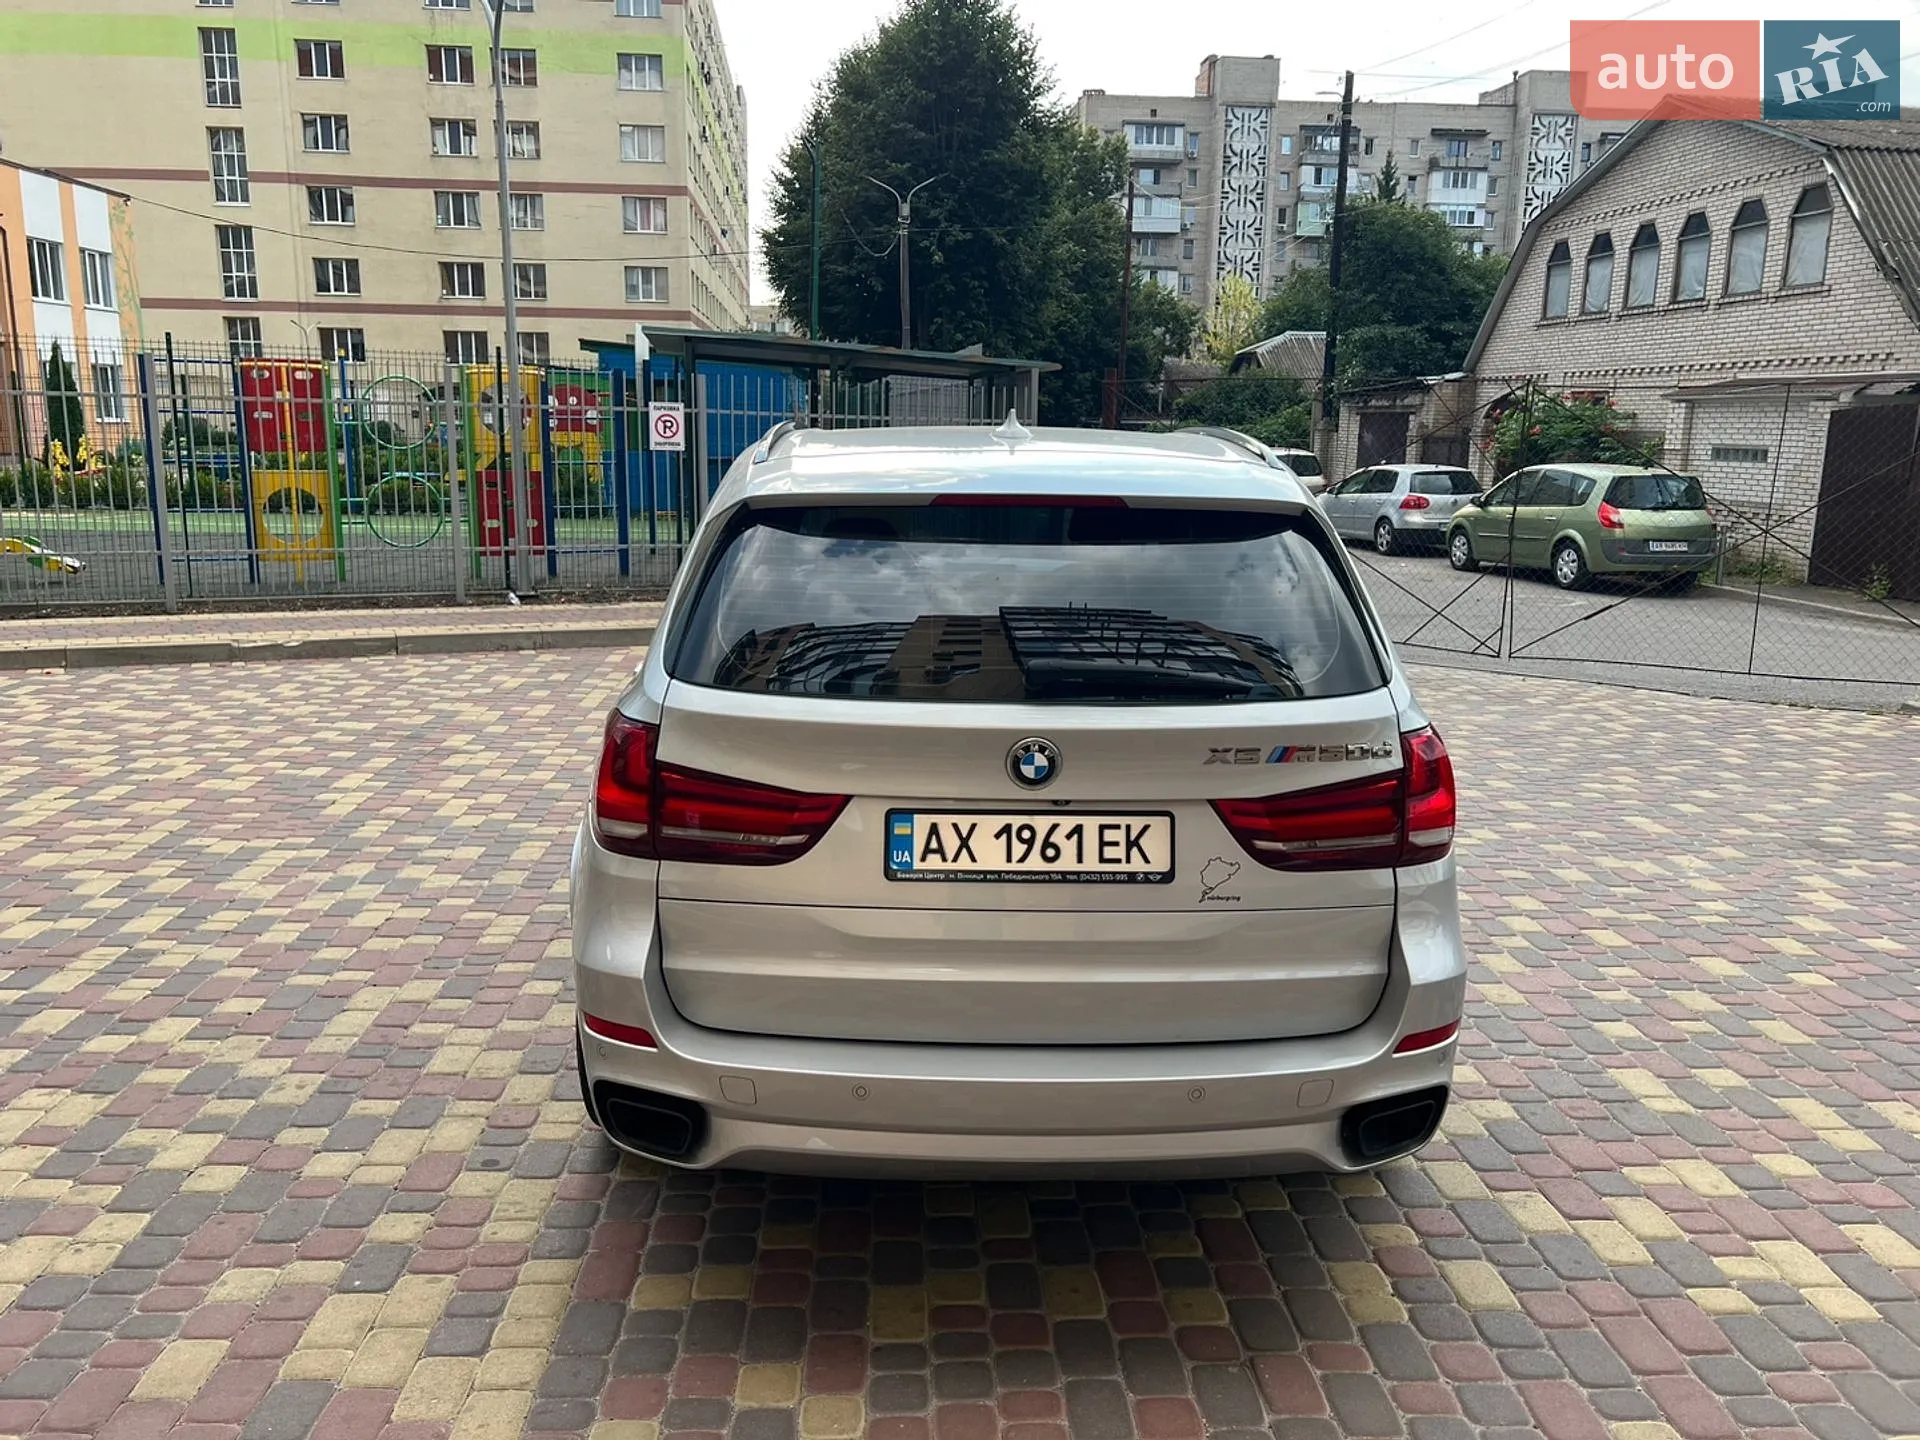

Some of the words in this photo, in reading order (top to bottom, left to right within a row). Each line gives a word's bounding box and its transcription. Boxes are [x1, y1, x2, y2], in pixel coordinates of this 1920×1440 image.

[1203, 746, 1262, 765] X5
[920, 822, 978, 863] AX
[993, 823, 1083, 864] 1961
[1098, 823, 1151, 864] EK
[893, 850, 911, 863] UA
